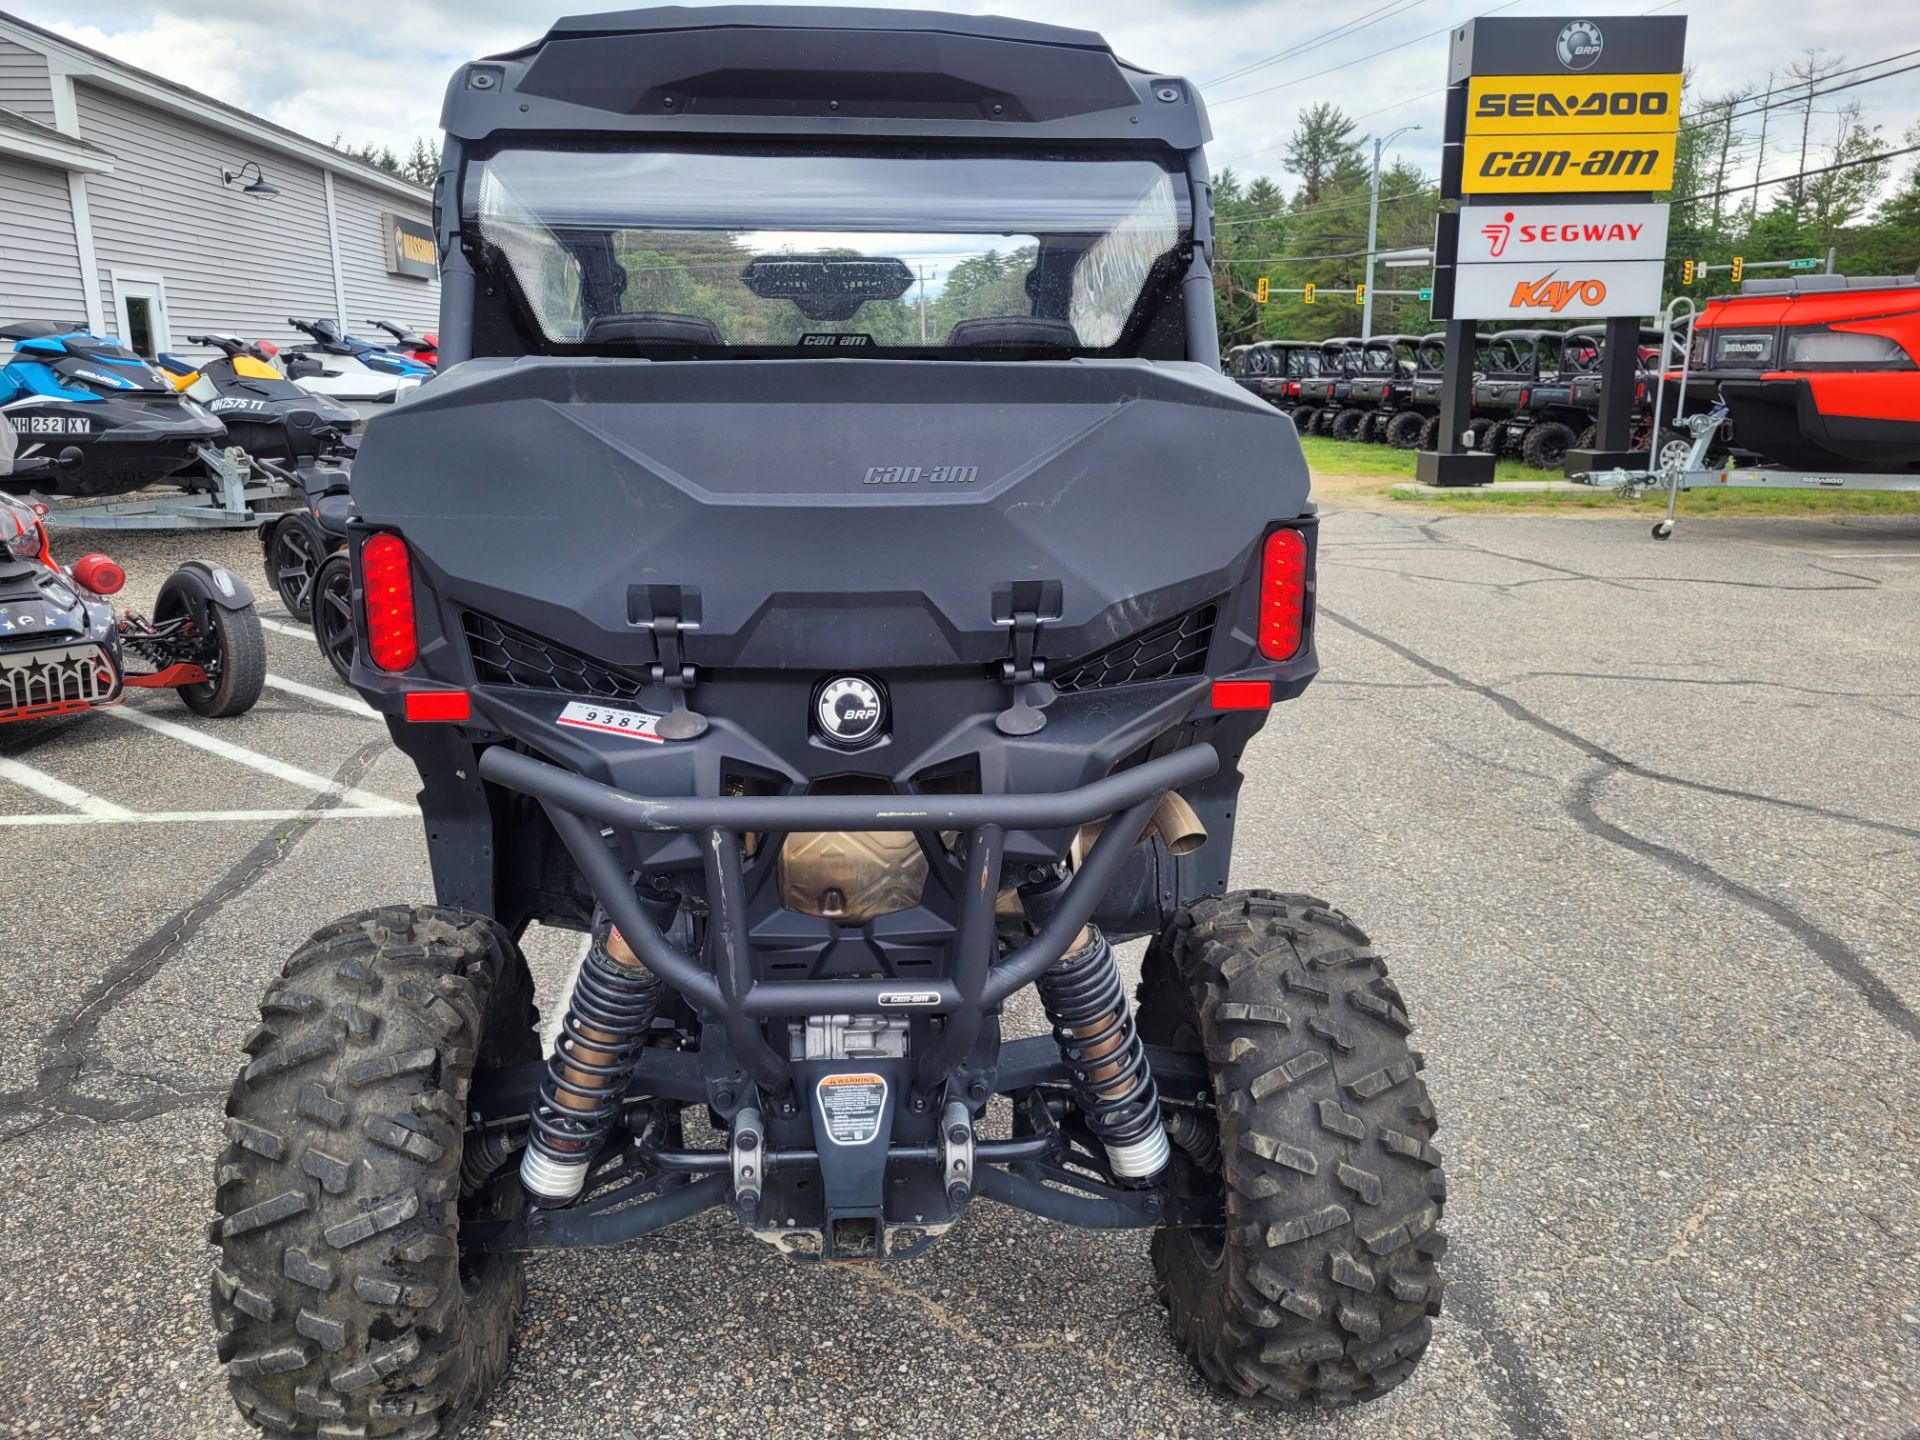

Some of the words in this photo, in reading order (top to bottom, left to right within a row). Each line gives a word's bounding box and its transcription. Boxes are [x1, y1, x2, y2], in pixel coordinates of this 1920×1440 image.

[1574, 46, 1600, 55] BRP
[1519, 224, 1643, 242] SEGWAY
[1509, 268, 1606, 312] KAYO
[33, 418, 65, 432] 2521
[69, 418, 89, 432] XY
[843, 709, 877, 720] BRP
[837, 1077, 875, 1085] WARNING
